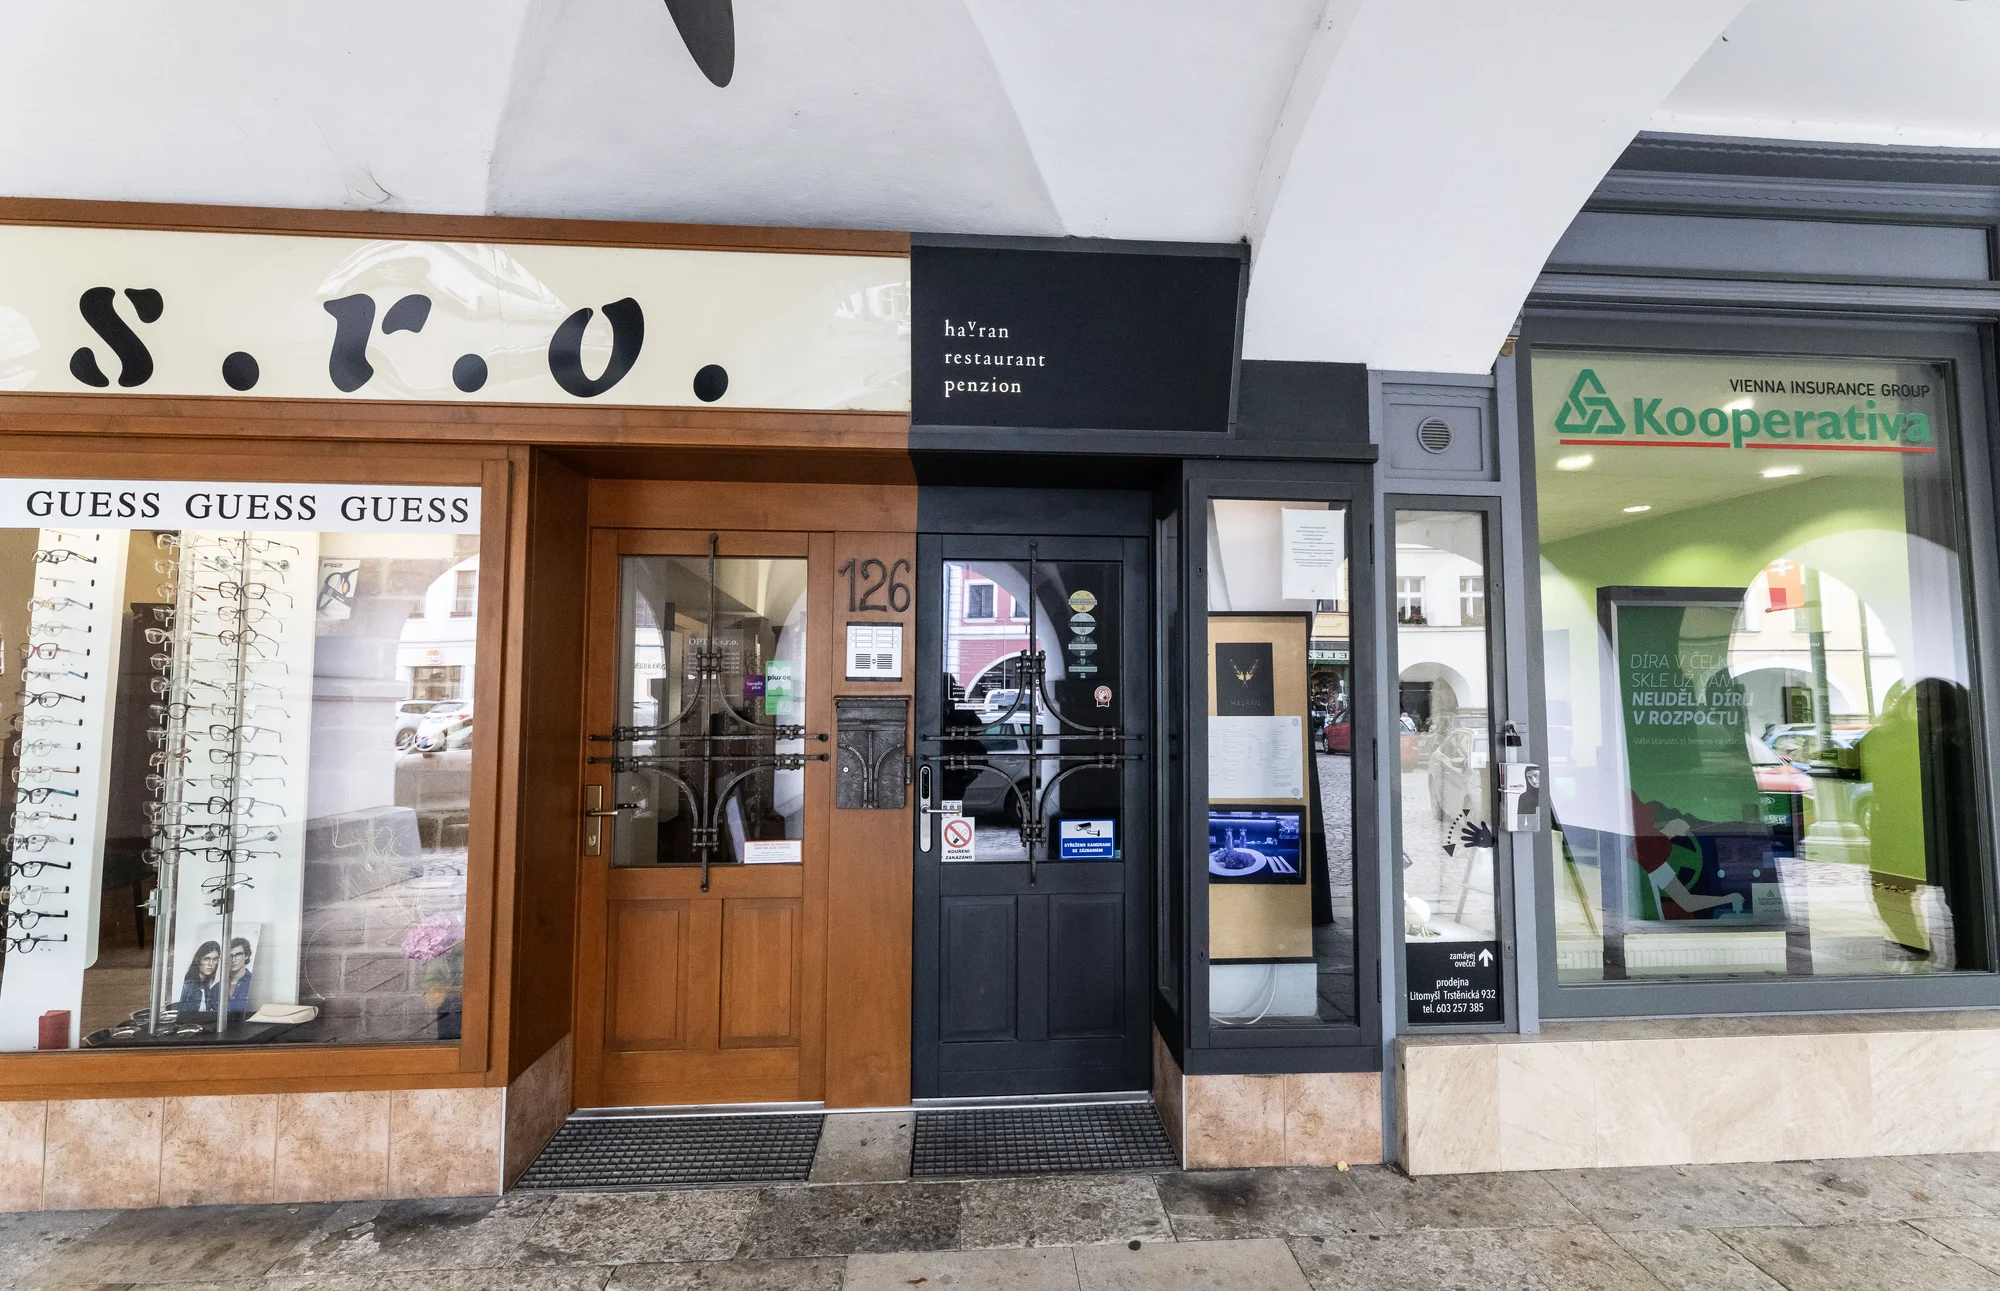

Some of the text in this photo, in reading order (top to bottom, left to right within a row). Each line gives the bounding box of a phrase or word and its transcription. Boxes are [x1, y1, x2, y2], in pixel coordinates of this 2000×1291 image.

[944, 319, 1009, 338] havran
[944, 353, 1045, 367] restaurant
[944, 376, 1021, 398] penzion
[1729, 378, 1930, 398] VIENNA INSURANCE GROUP
[1632, 398, 1935, 449] Kooperativa
[26, 490, 469, 524] GUESS GUESS GUESS
[838, 557, 911, 613] 126
[688, 637, 719, 646] OPTK
[1630, 651, 1669, 669] DÍRA
[1674, 654, 1686, 669] V
[1631, 672, 1669, 688] SKLE
[1673, 670, 1695, 688] UŽ
[1632, 688, 1754, 707] NEUDĚLÁ DÍRU
[1633, 707, 1739, 726] V ROZPOČTU
[1449, 951, 1476, 962] zamávej
[1454, 960, 1476, 968] ovečce
[1436, 976, 1469, 989] prodejna
[1409, 989, 1496, 1003] Litomyšl Trstěnická 932
[1422, 1002, 1484, 1014] tel. 603 257 385
